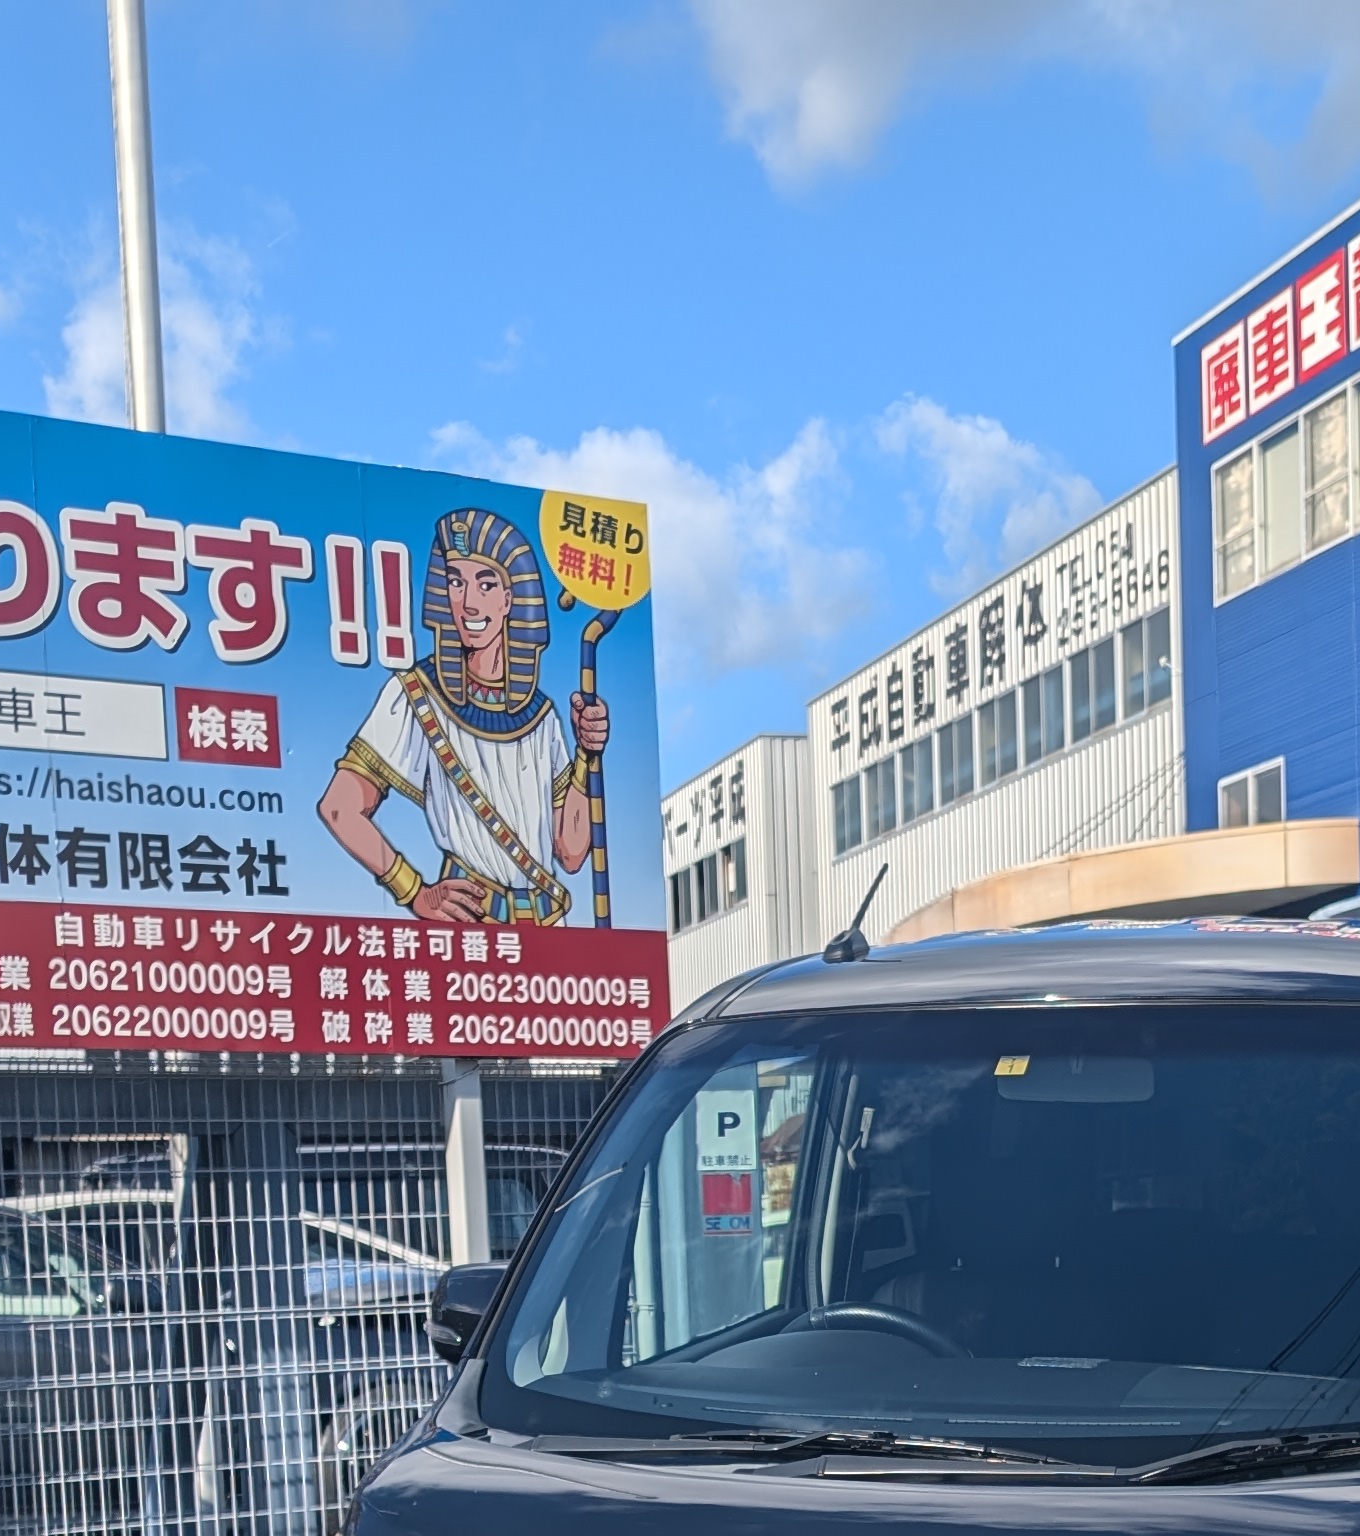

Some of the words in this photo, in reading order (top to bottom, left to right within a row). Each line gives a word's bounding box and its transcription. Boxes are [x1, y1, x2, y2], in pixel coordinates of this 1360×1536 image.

[559, 501, 645, 556] 見積り
[557, 542, 633, 597] 無料！
[187, 704, 270, 754] 検索
[54, 914, 522, 964] 自動車リサイクル法許可番号
[48, 959, 293, 999] 20621000009号
[319, 968, 432, 1003] 解体業
[446, 974, 651, 1008] 20623000009号
[52, 1004, 295, 1043] 20622000009号
[322, 1011, 433, 1046] 破砕業
[448, 1014, 653, 1049] 20624000009号
[717, 1111, 741, 1137] P
[701, 1155, 752, 1167] 駐車禁止
[705, 1216, 750, 1231] SEOM
